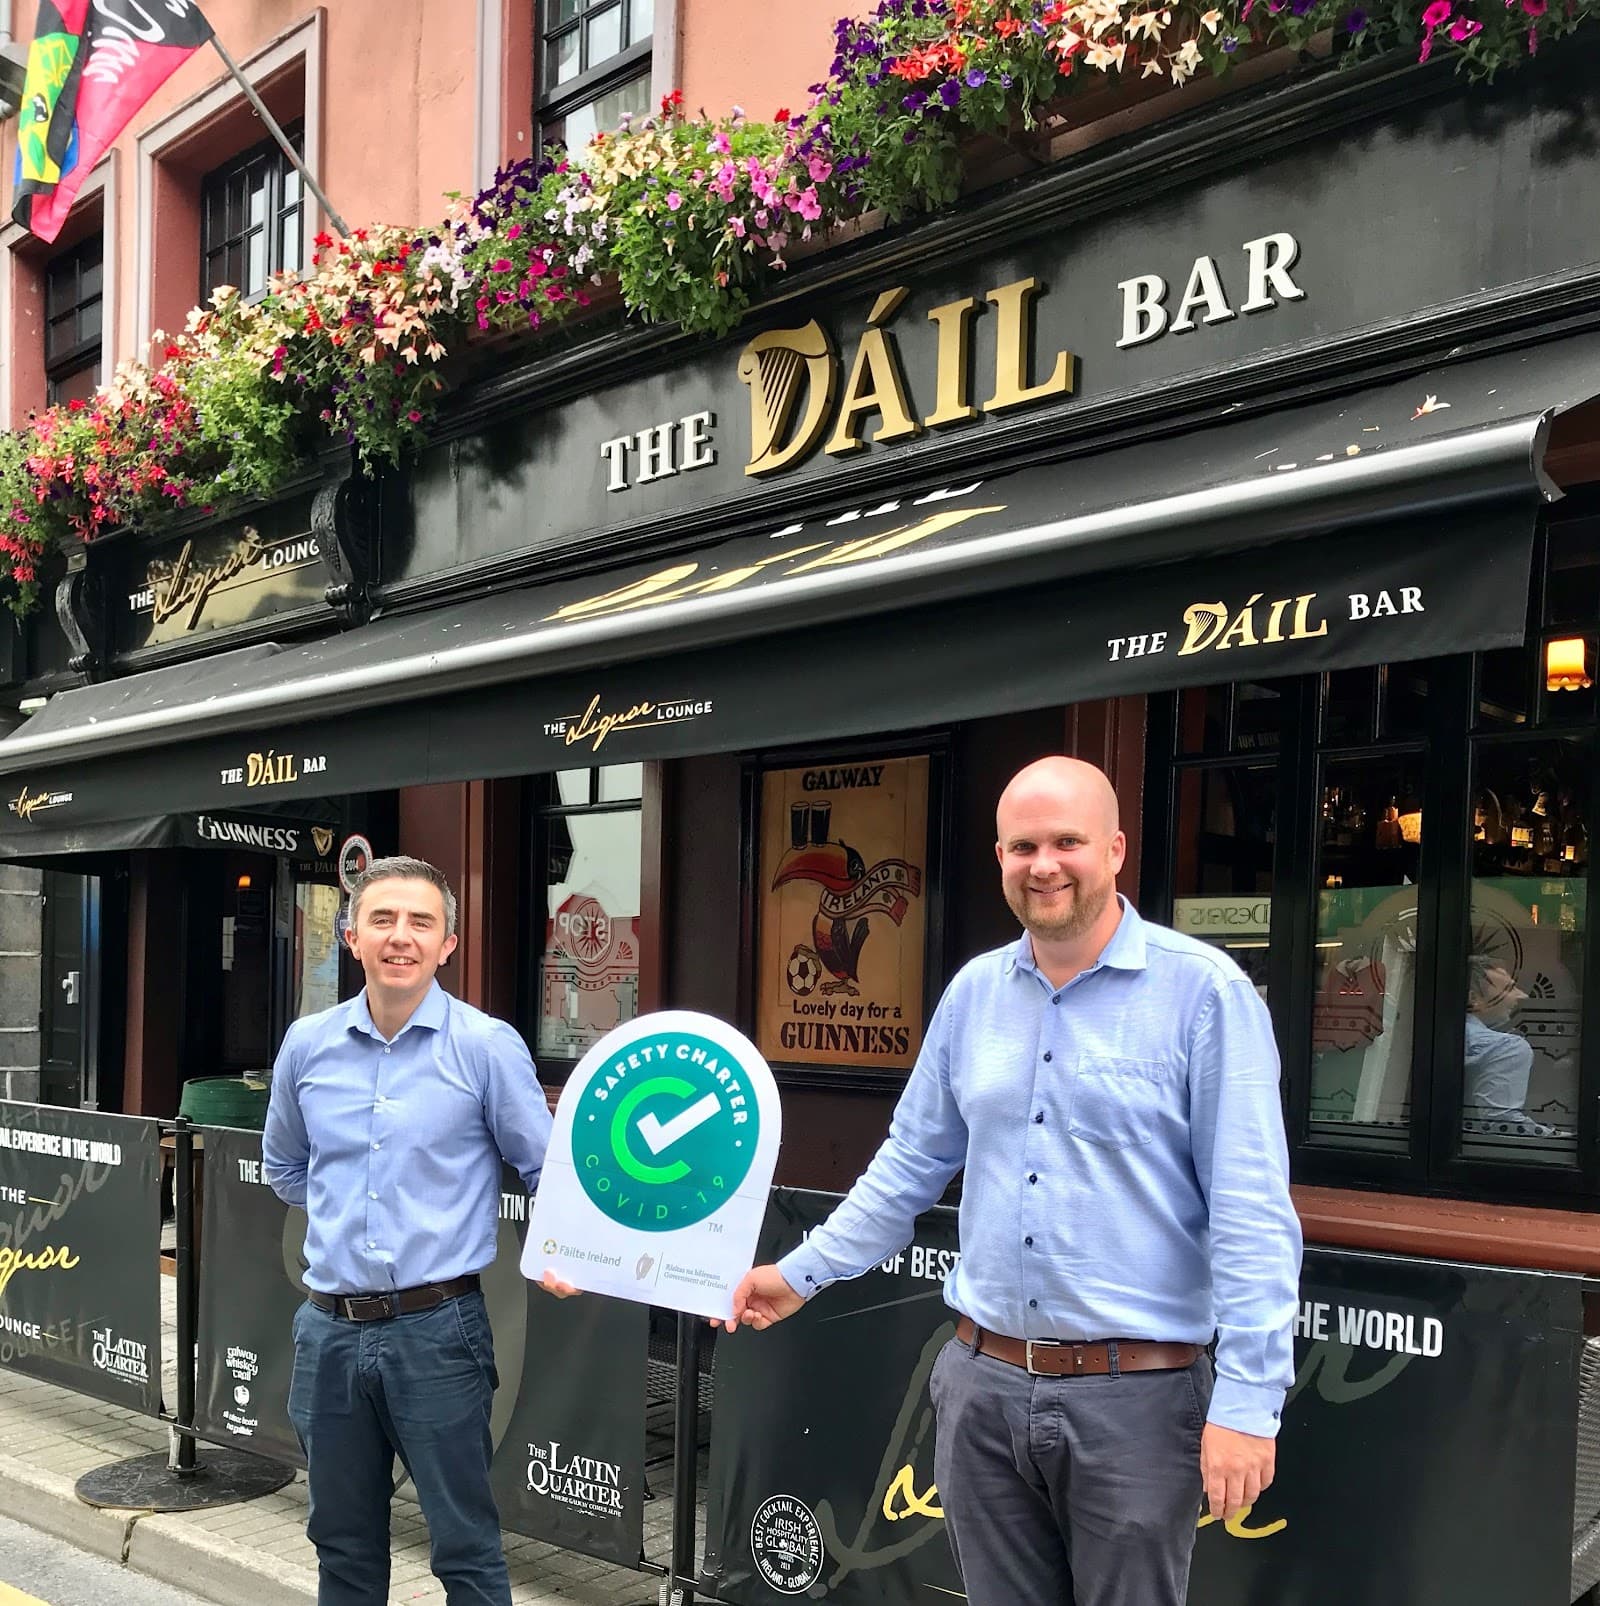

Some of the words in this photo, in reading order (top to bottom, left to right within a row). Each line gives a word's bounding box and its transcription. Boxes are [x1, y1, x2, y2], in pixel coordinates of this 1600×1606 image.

[601, 411, 715, 493] THE
[736, 276, 1075, 478] DÁIL
[1116, 232, 1304, 349] BAR
[129, 589, 154, 610] THE
[153, 539, 265, 630] Liquor
[263, 539, 319, 570] LOUNG
[1107, 631, 1167, 662] THE
[1177, 592, 1328, 656] DÁIL
[1348, 586, 1425, 621] BAR
[544, 722, 566, 735] THE
[565, 694, 656, 751] Liquor
[657, 701, 713, 720] LOUNGE
[221, 768, 243, 784] THE
[247, 750, 297, 787] DÁIL
[303, 756, 326, 773] BAR
[802, 765, 885, 792] GALWAY
[197, 815, 298, 852] GUINNESS
[823, 867, 890, 912] IRELAND
[793, 1000, 837, 1019] Lovely
[840, 1001, 864, 1019] day
[867, 1002, 890, 1018] for
[893, 1005, 902, 1018] a
[780, 1022, 910, 1055] GUINNESS
[595, 1043, 669, 1101] SAFETY
[675, 1044, 748, 1126] CHARTER
[13, 1129, 61, 1156] EXPERIENCE
[62, 1137, 71, 1157] IN
[72, 1138, 89, 1161] THE
[90, 1141, 121, 1165] WORLD
[238, 1159, 259, 1184] THE
[0, 1186, 26, 1205] THE
[587, 1251, 622, 1267] Ireland
[105, 1327, 147, 1361] LATIN
[1293, 1301, 1330, 1341] HE
[1338, 1305, 1443, 1358] WORLD
[93, 1342, 149, 1378] QUARTER
[227, 1346, 257, 1364] galway
[528, 1443, 547, 1459] THE
[548, 1441, 620, 1487] LATIN
[527, 1460, 624, 1509] QUARTER
[755, 1523, 764, 1549] BEST
[760, 1501, 793, 1524] COCKTAIL
[794, 1505, 819, 1566] EXPERIENCE
[767, 1527, 808, 1544] HOSPITALITY
[775, 1518, 801, 1534] IRISH
[760, 1558, 783, 1585] IRELAND
[787, 1571, 811, 1588] GLOBAL
